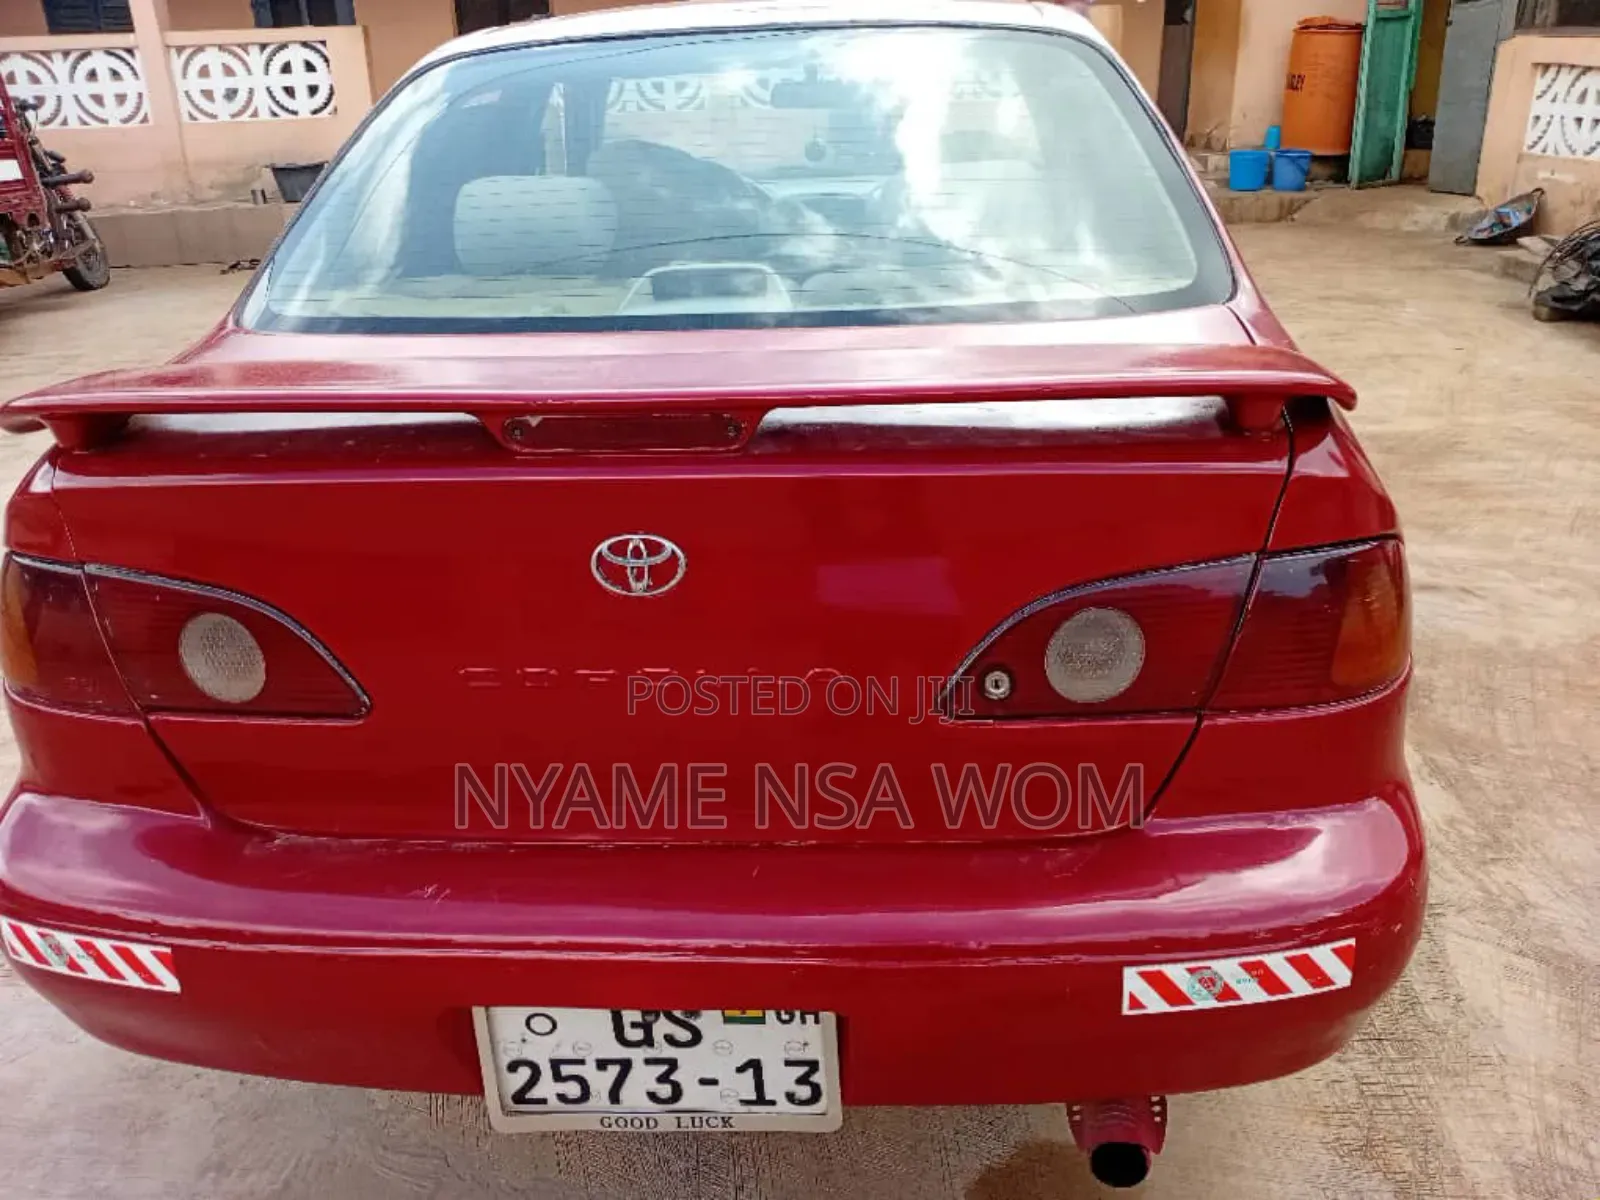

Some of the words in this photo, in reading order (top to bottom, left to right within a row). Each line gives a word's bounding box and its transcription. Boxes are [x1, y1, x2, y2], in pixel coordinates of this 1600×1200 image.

[610, 1009, 703, 1049] GS
[506, 1057, 823, 1106] 2573-13
[600, 1116, 659, 1130] GOOD
[675, 1116, 735, 1129] LUCK
